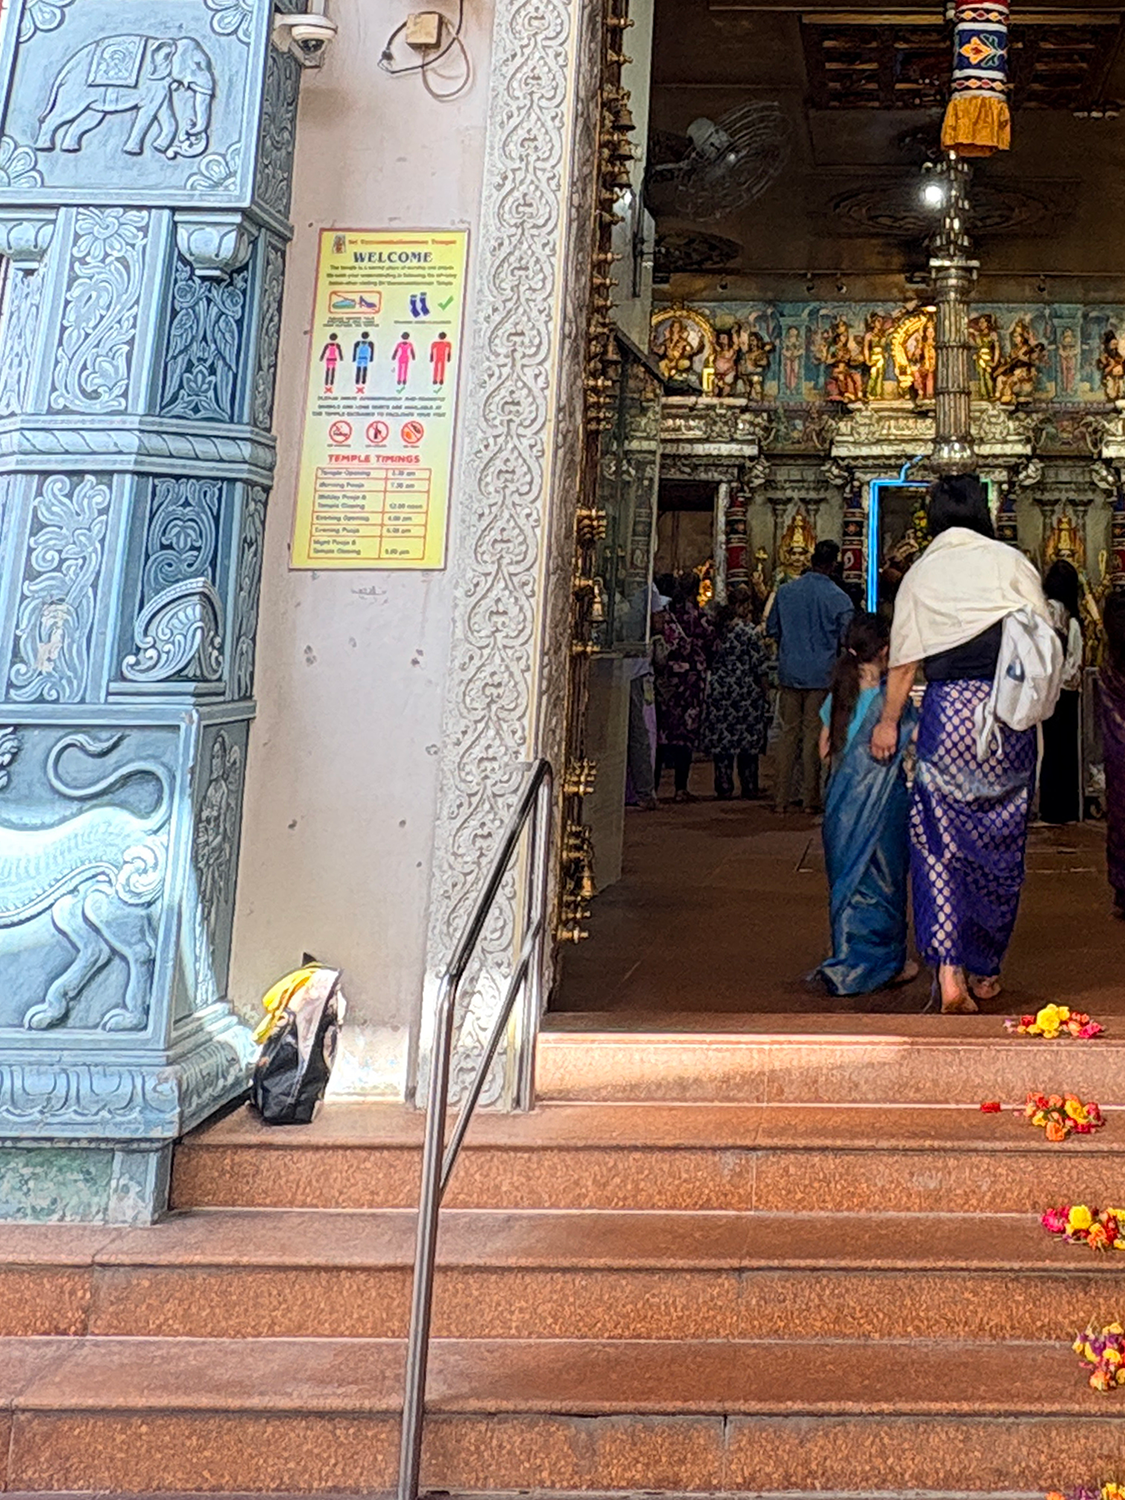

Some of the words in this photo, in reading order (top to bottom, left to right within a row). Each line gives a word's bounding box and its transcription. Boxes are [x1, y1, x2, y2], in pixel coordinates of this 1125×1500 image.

[353, 252, 433, 263] WELCOME
[328, 455, 370, 463] TEMPLE
[375, 455, 420, 463] TIMINGS
